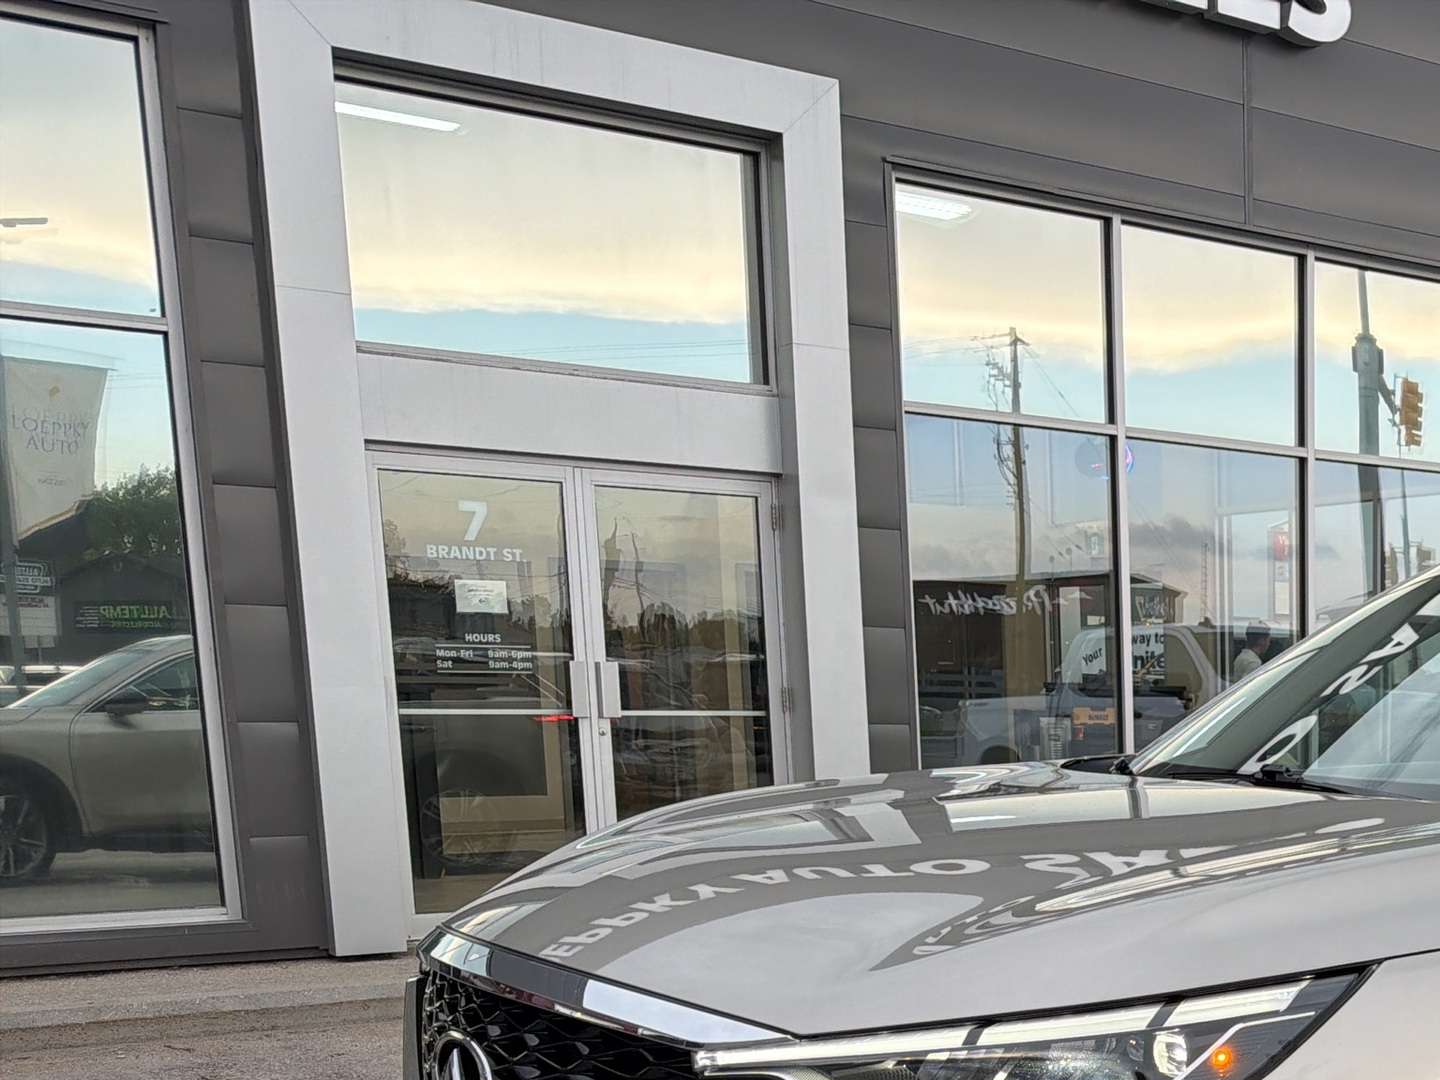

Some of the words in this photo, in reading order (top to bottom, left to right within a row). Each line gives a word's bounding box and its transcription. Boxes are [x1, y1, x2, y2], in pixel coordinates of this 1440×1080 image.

[458, 501, 488, 541] 7
[426, 544, 497, 560] BRANDT
[465, 633, 502, 643] HOURS
[437, 660, 453, 668] Sat
[1082, 647, 1103, 666] Your
